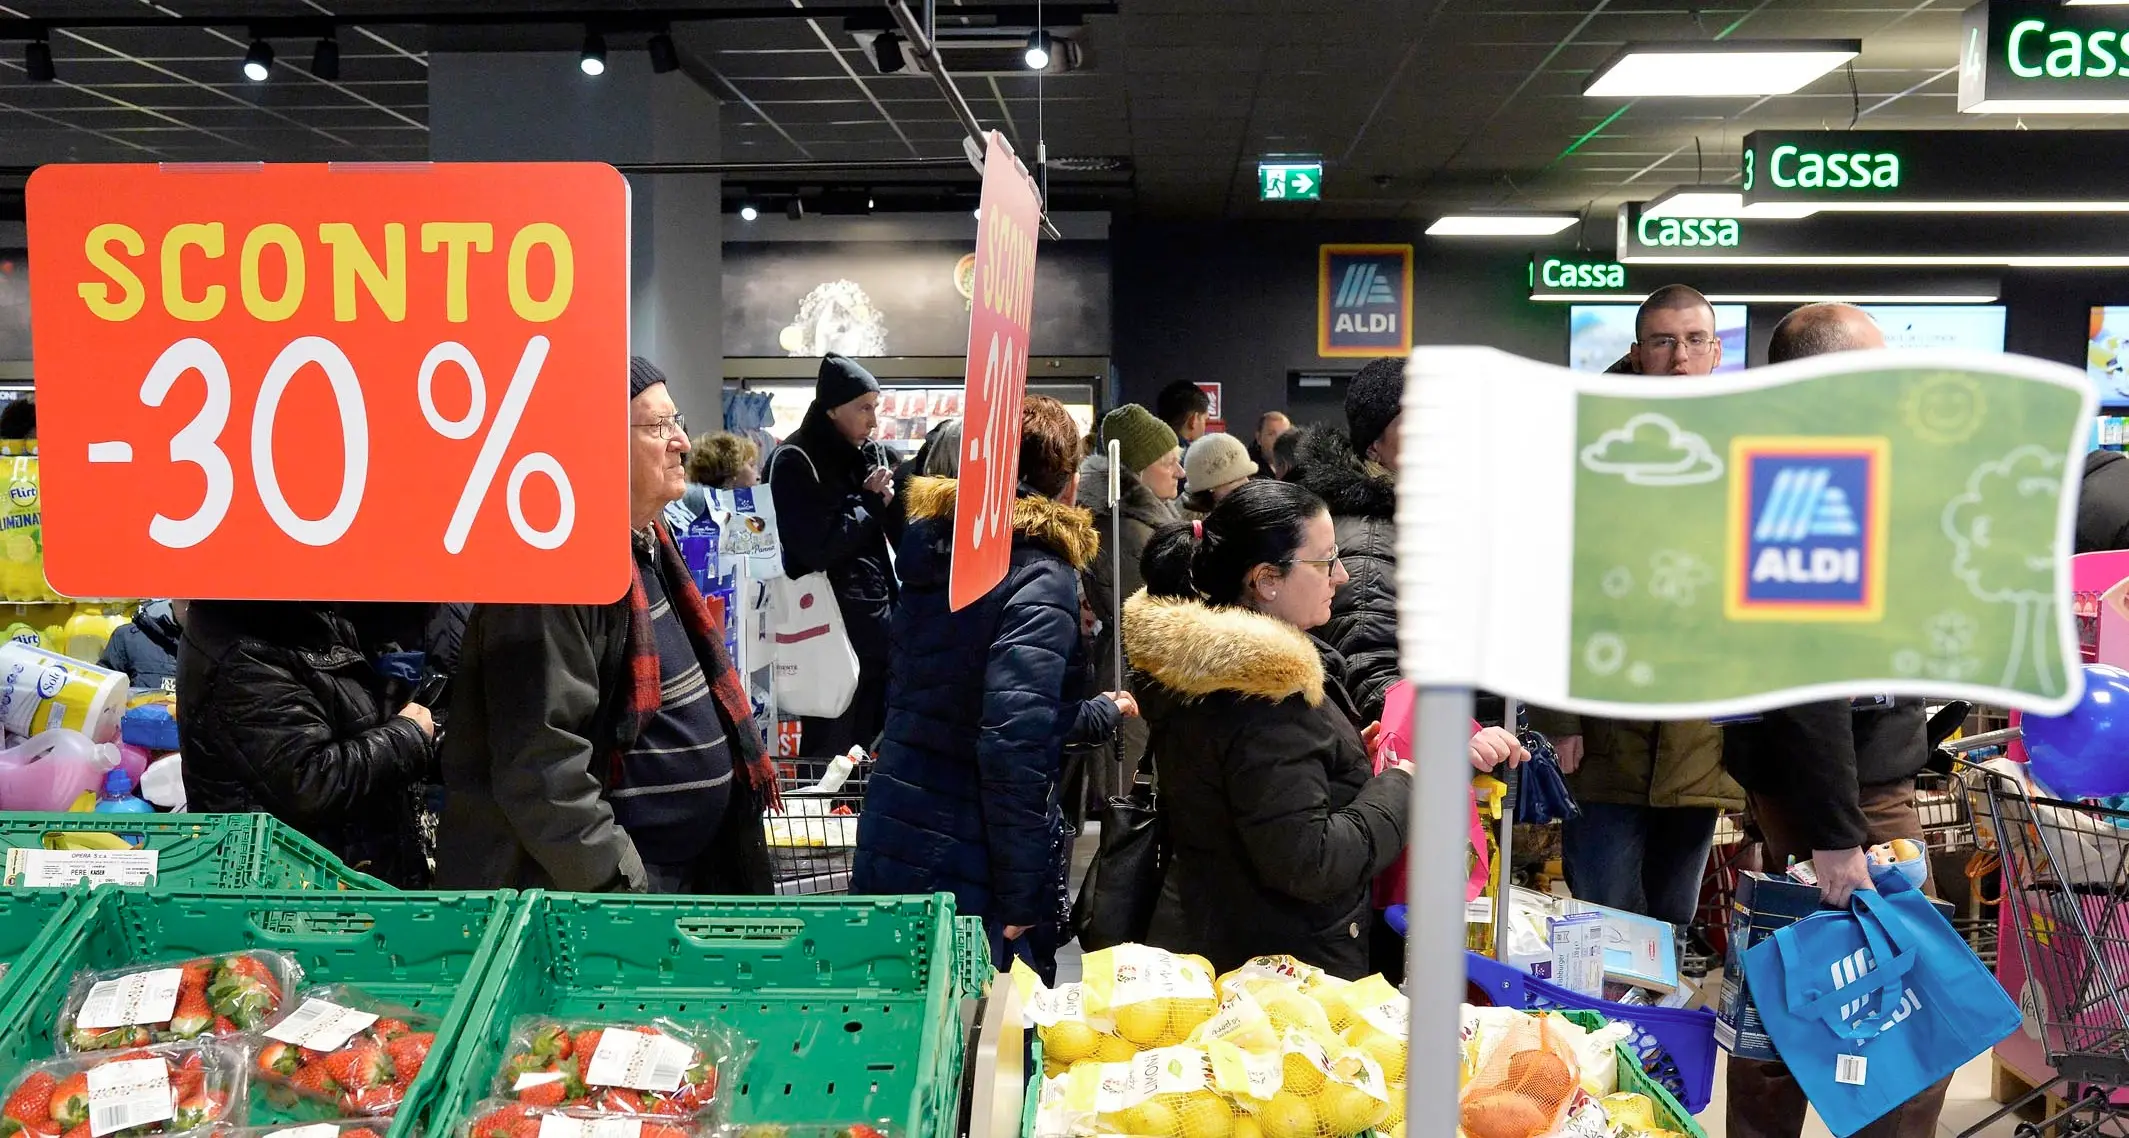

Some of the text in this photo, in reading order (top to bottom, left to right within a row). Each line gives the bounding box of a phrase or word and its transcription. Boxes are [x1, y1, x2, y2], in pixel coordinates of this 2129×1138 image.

[1963, 26, 1982, 82] 4
[1743, 145, 1900, 191] 3 Cassa
[1638, 213, 1740, 247] Cassa
[78, 222, 575, 323] SCONTO
[1542, 259, 1625, 288] Cassa
[1334, 313, 1396, 333] ALDI
[87, 335, 577, 555] -30 %
[10, 487, 36, 498] Flirt
[1752, 547, 1860, 584] ALDI
